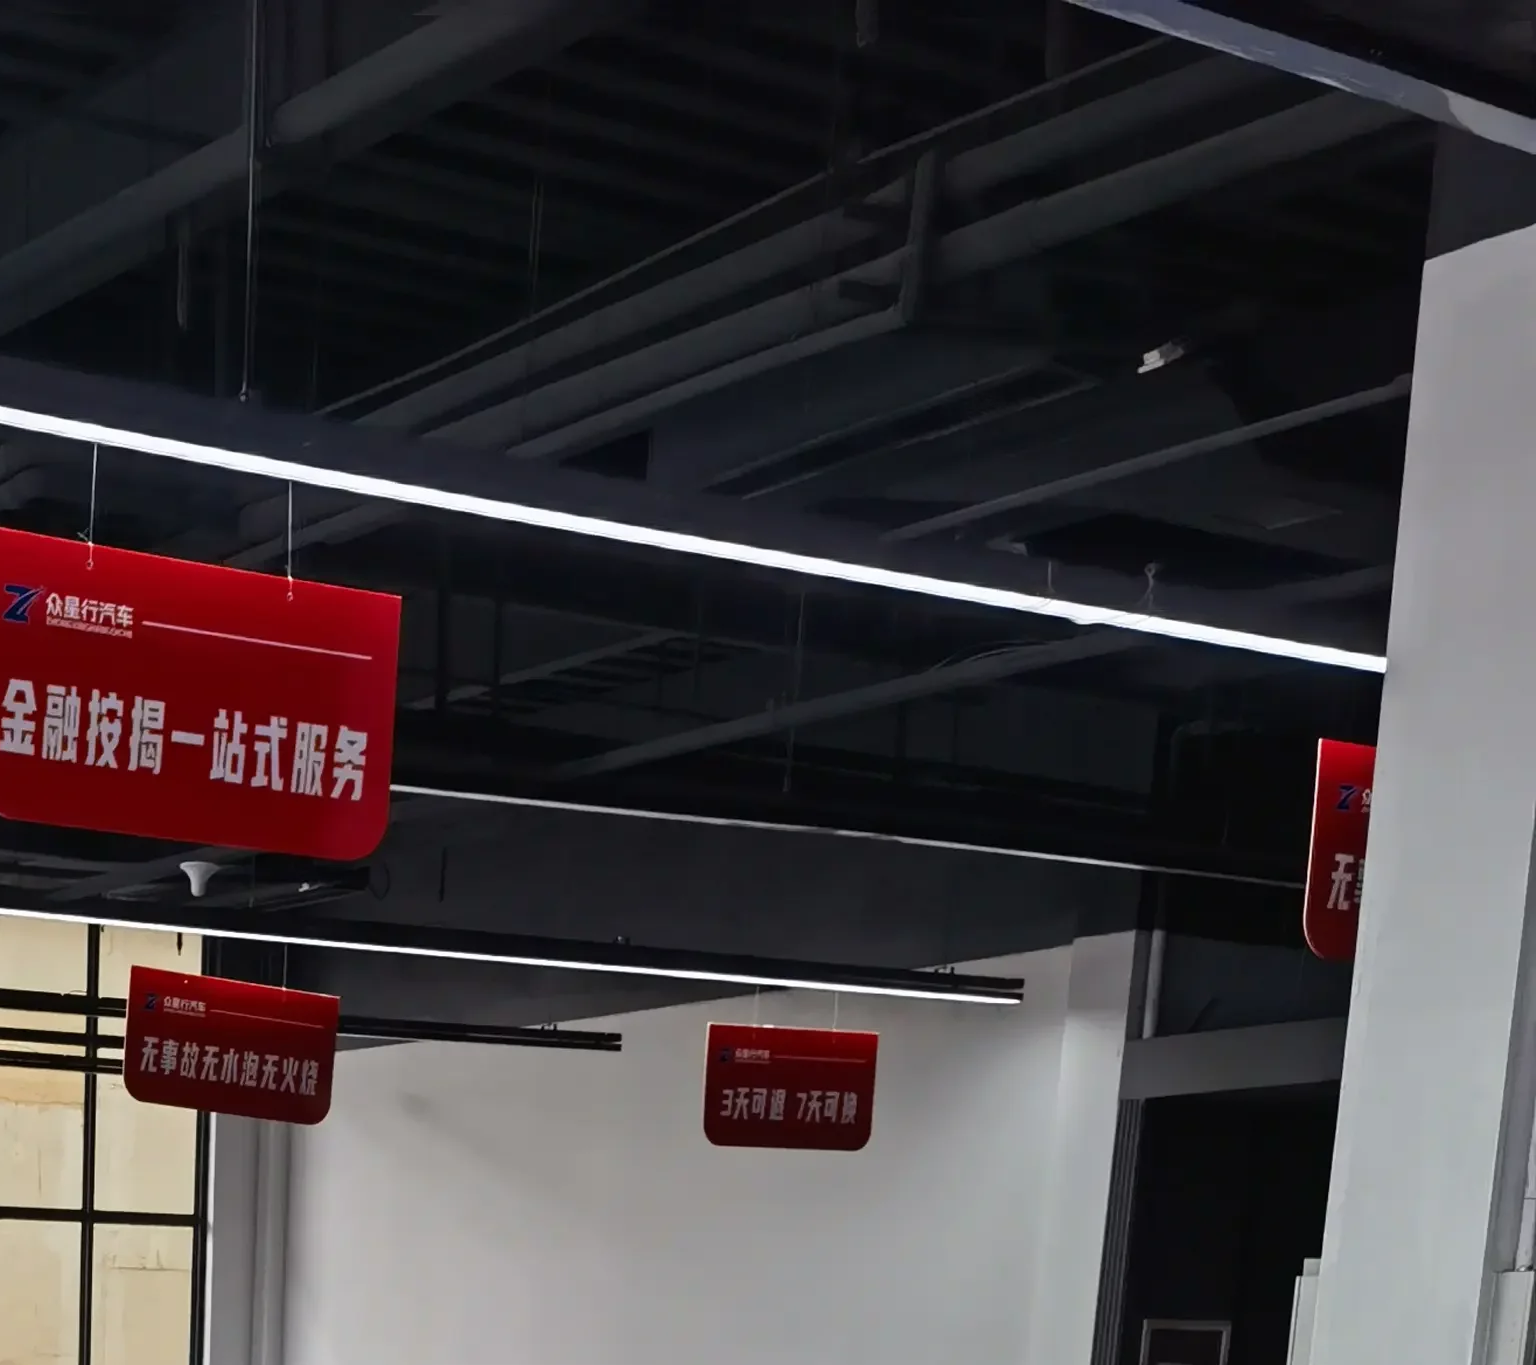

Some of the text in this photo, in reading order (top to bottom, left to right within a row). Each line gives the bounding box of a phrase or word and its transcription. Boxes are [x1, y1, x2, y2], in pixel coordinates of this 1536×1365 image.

[45, 592, 134, 628] 众星行汽车
[139, 1036, 320, 1096] 无事故无水泡无火烧
